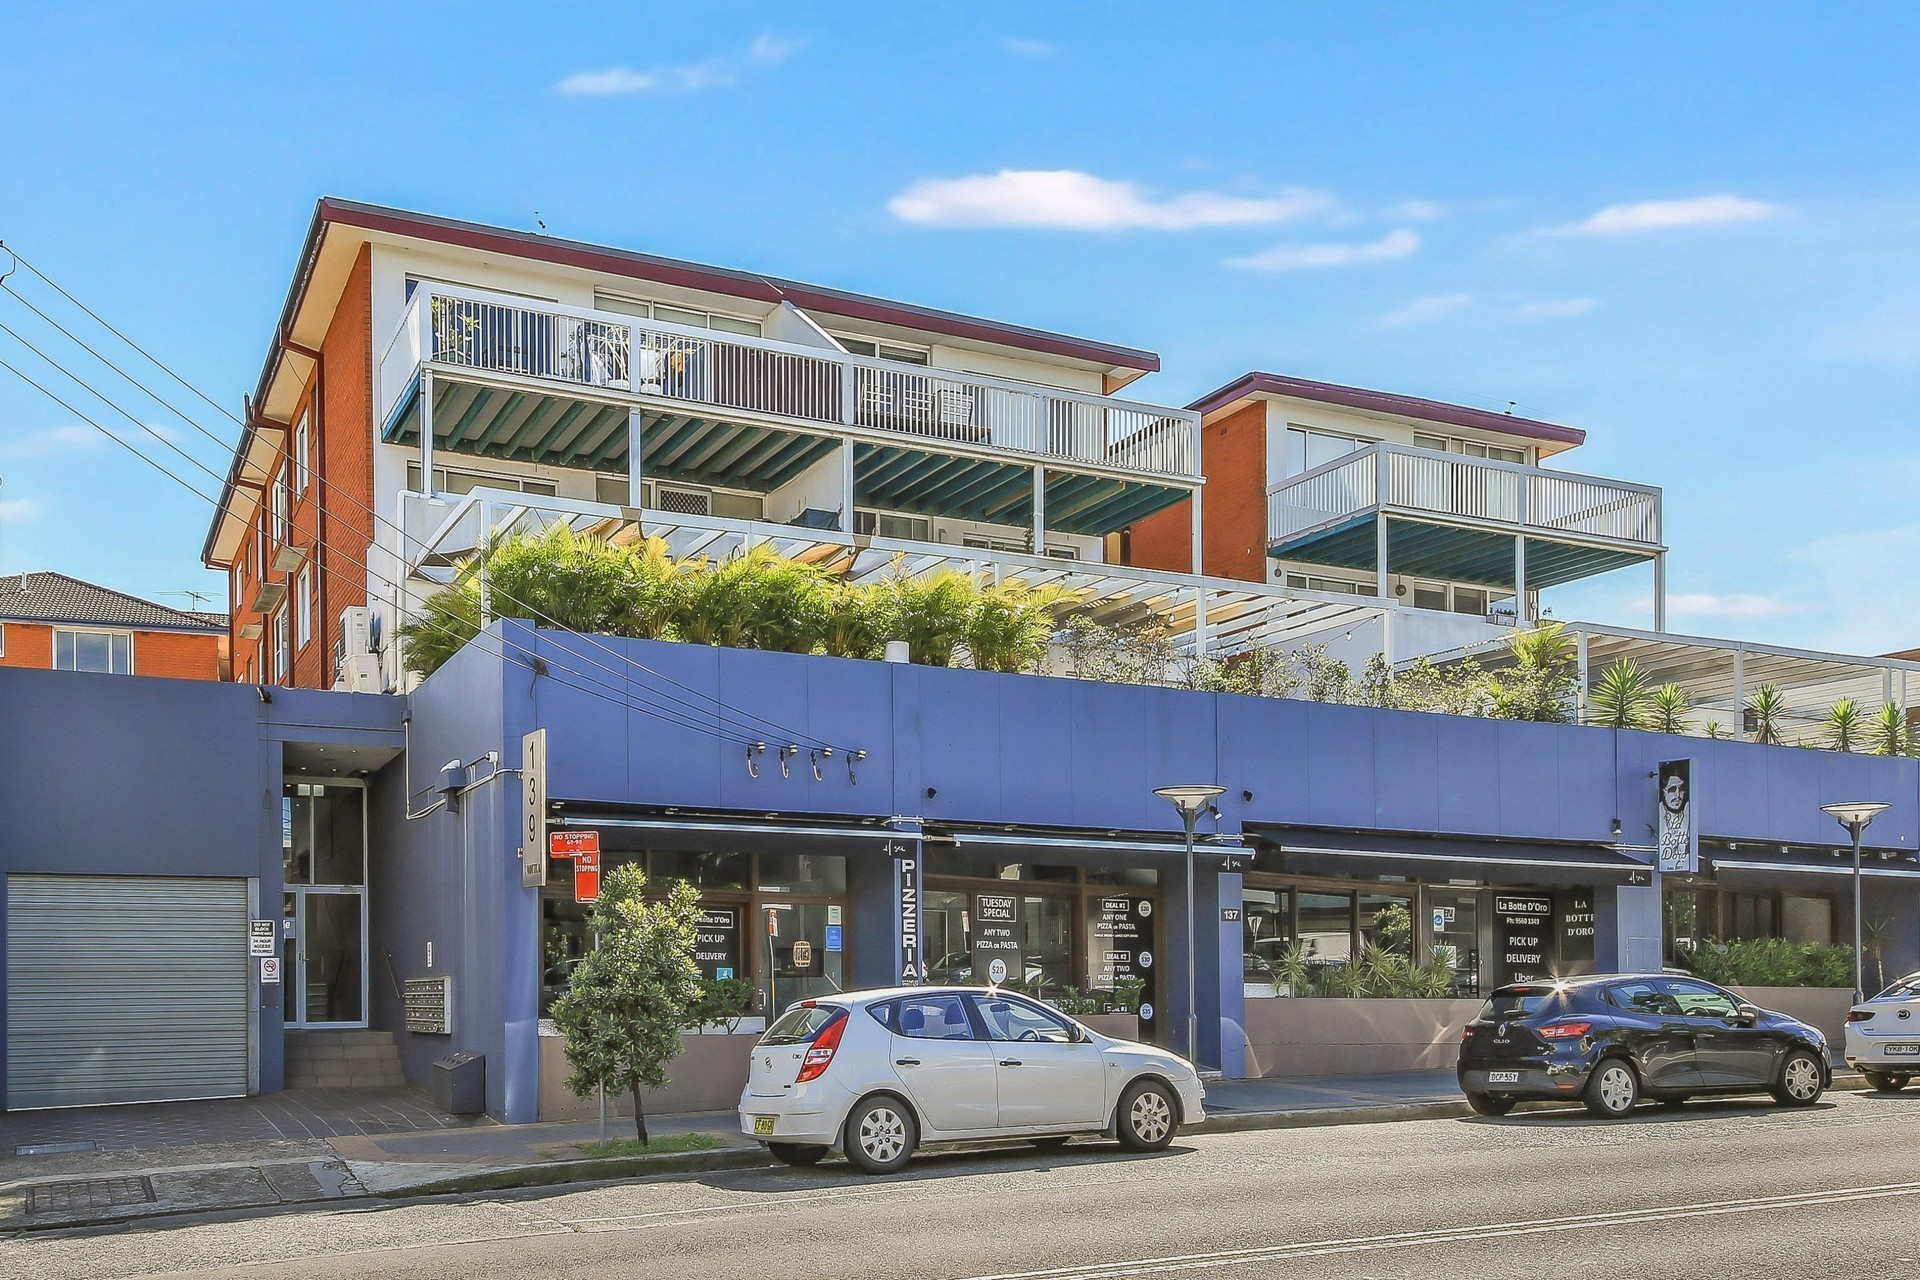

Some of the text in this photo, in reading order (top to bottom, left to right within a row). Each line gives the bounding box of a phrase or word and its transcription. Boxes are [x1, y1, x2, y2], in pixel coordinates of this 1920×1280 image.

[981, 898, 1012, 908] TUESDAY
[1499, 901, 1548, 912] La Botte D'Oro
[902, 859, 918, 977] PIZZERIA
[983, 908, 1011, 918] SPECIAL
[1223, 910, 1238, 919] 137
[984, 928, 1011, 937] ANY TWO
[1567, 927, 1594, 936] D'ORO
[697, 934, 725, 943] PICK UP
[1509, 937, 1538, 947] PICK UP
[976, 941, 993, 949] PIZZA
[1000, 941, 1018, 949] PASTA
[695, 952, 727, 960] DELIVERY
[1506, 954, 1541, 964] DELIVERY
[991, 964, 1004, 976] $20
[1514, 972, 1534, 982] Uber
